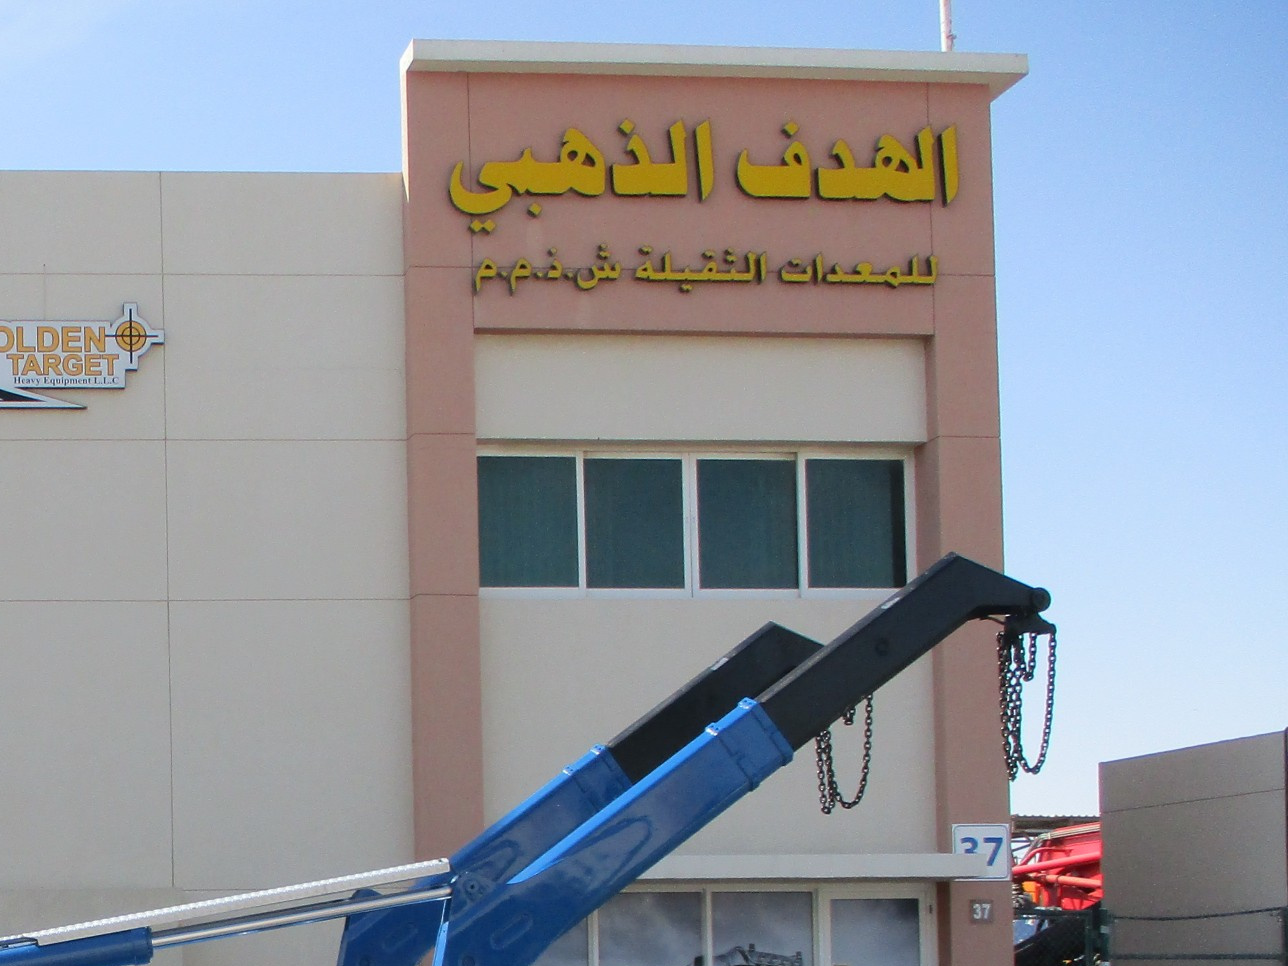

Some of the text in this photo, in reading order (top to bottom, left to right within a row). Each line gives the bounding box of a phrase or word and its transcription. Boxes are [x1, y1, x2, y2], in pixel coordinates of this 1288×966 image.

[448, 118, 960, 234] الهدف الذهبي
[635, 244, 768, 291] الثقيلة
[779, 249, 939, 289] للمعدات
[6, 353, 119, 376] TARGET
[13, 376, 41, 386] Heavy
[43, 376, 92, 386] Equipment
[960, 836, 1004, 867] 37
[972, 903, 992, 920] 37
